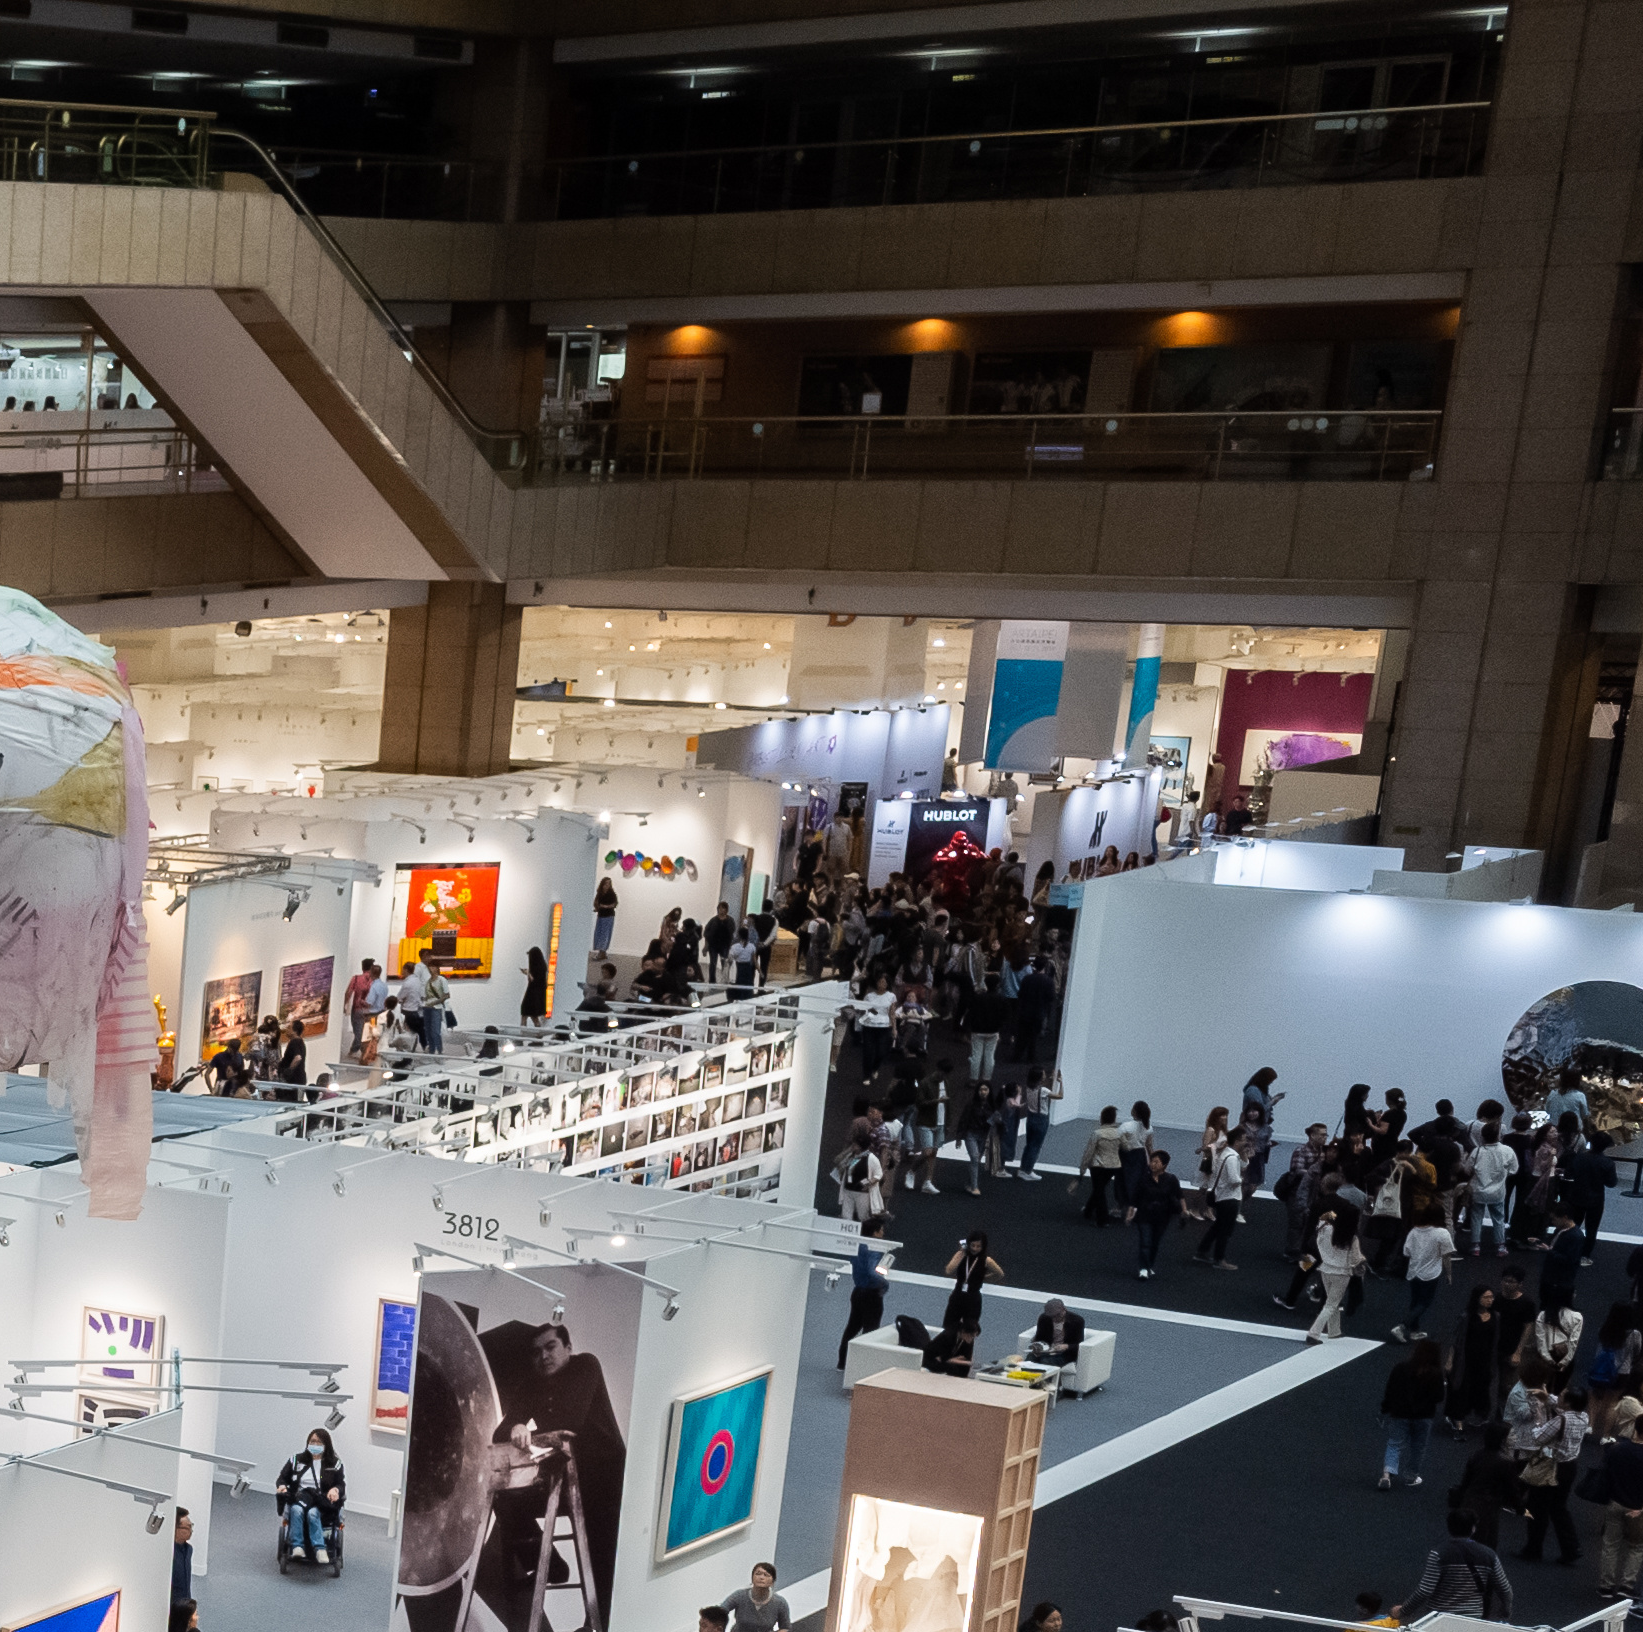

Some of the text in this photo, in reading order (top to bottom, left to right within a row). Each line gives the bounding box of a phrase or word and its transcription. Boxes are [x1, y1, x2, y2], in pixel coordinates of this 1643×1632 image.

[923, 809, 977, 822] HUBLOT
[442, 1211, 499, 1241] 3812
[840, 1223, 859, 1233] H01
